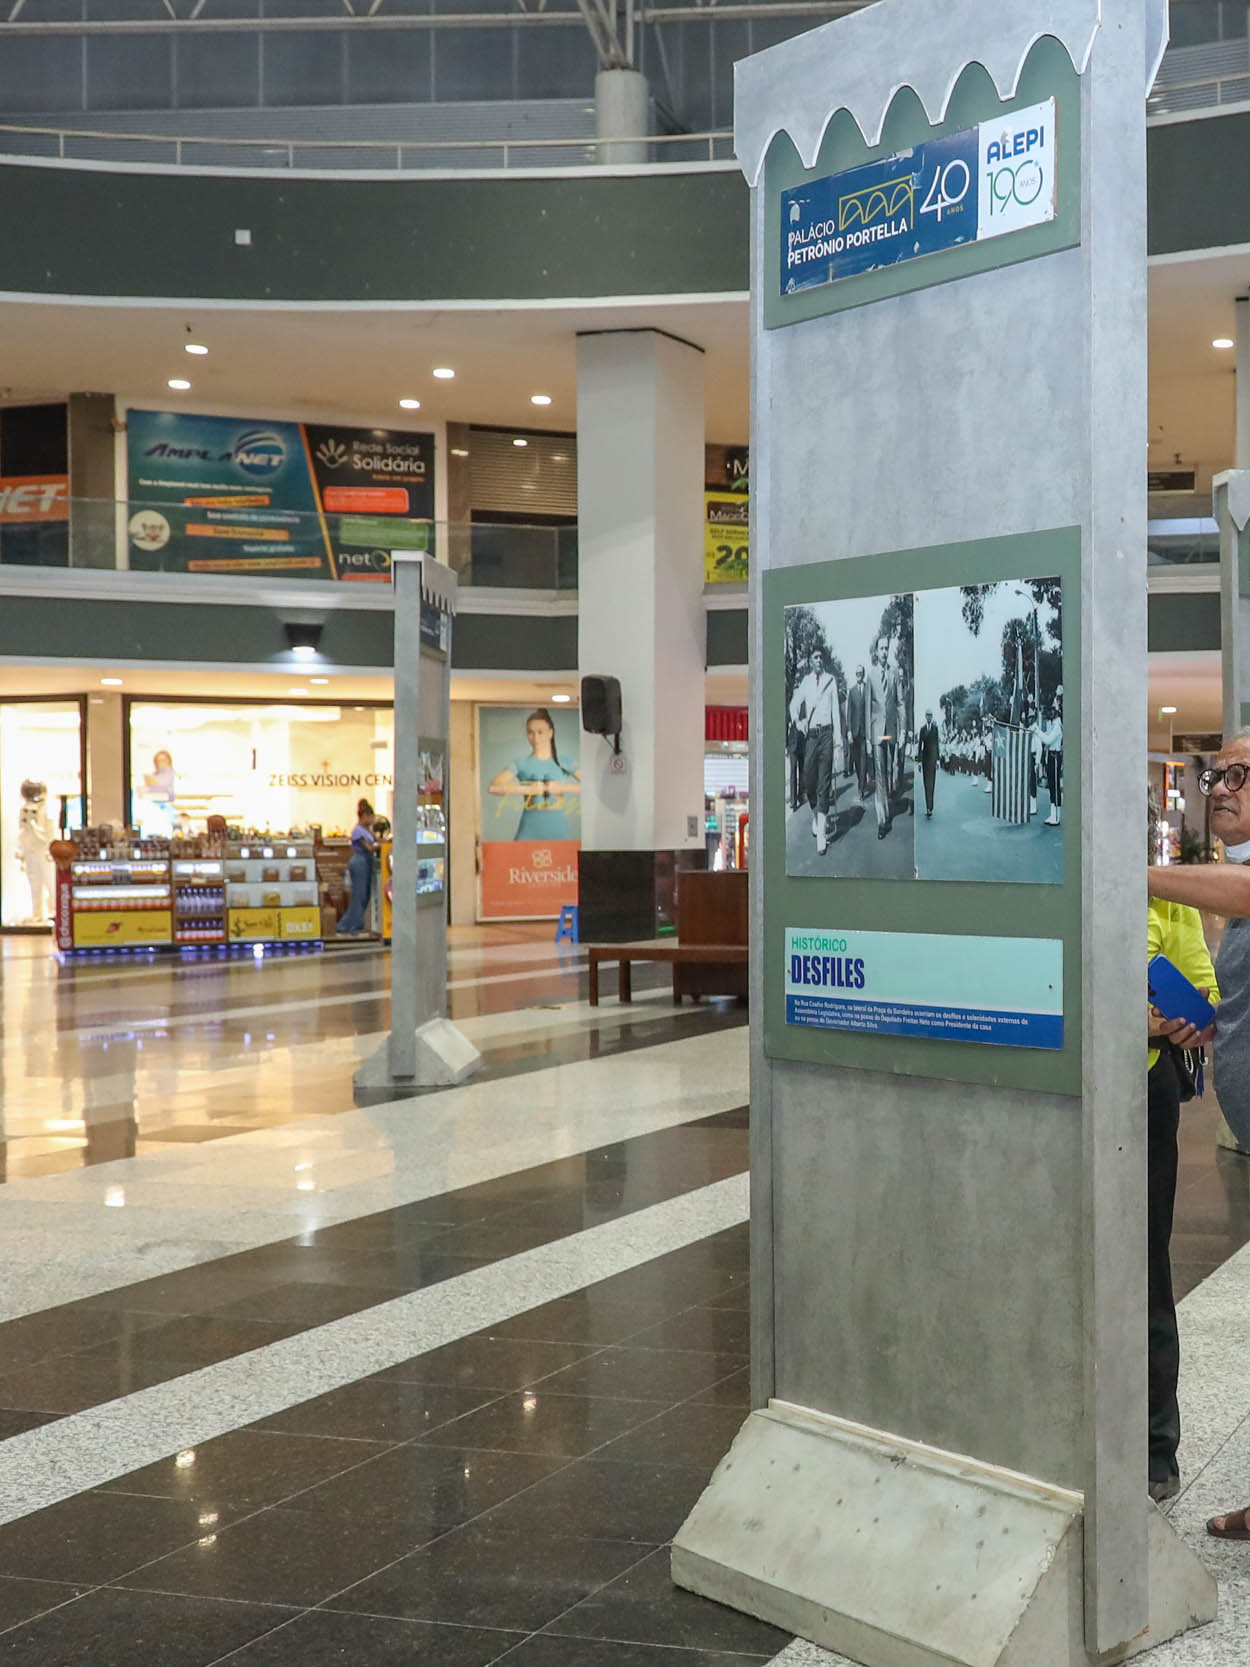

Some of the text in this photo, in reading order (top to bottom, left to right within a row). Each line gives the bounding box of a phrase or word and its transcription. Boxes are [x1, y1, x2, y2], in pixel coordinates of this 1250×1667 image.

[987, 126, 1044, 164] ALEPI
[920, 160, 969, 222] 40
[987, 160, 1043, 216] 190
[788, 219, 835, 246] PALÁCIO
[788, 217, 908, 266] PETRÔNIO PORTELLA
[353, 441, 419, 454] Rede Social
[352, 454, 426, 473] Solidária
[269, 774, 393, 787] ZEISS VISION CEN
[792, 935, 847, 952] HISTÓRICO
[791, 954, 865, 989] DESFILES
